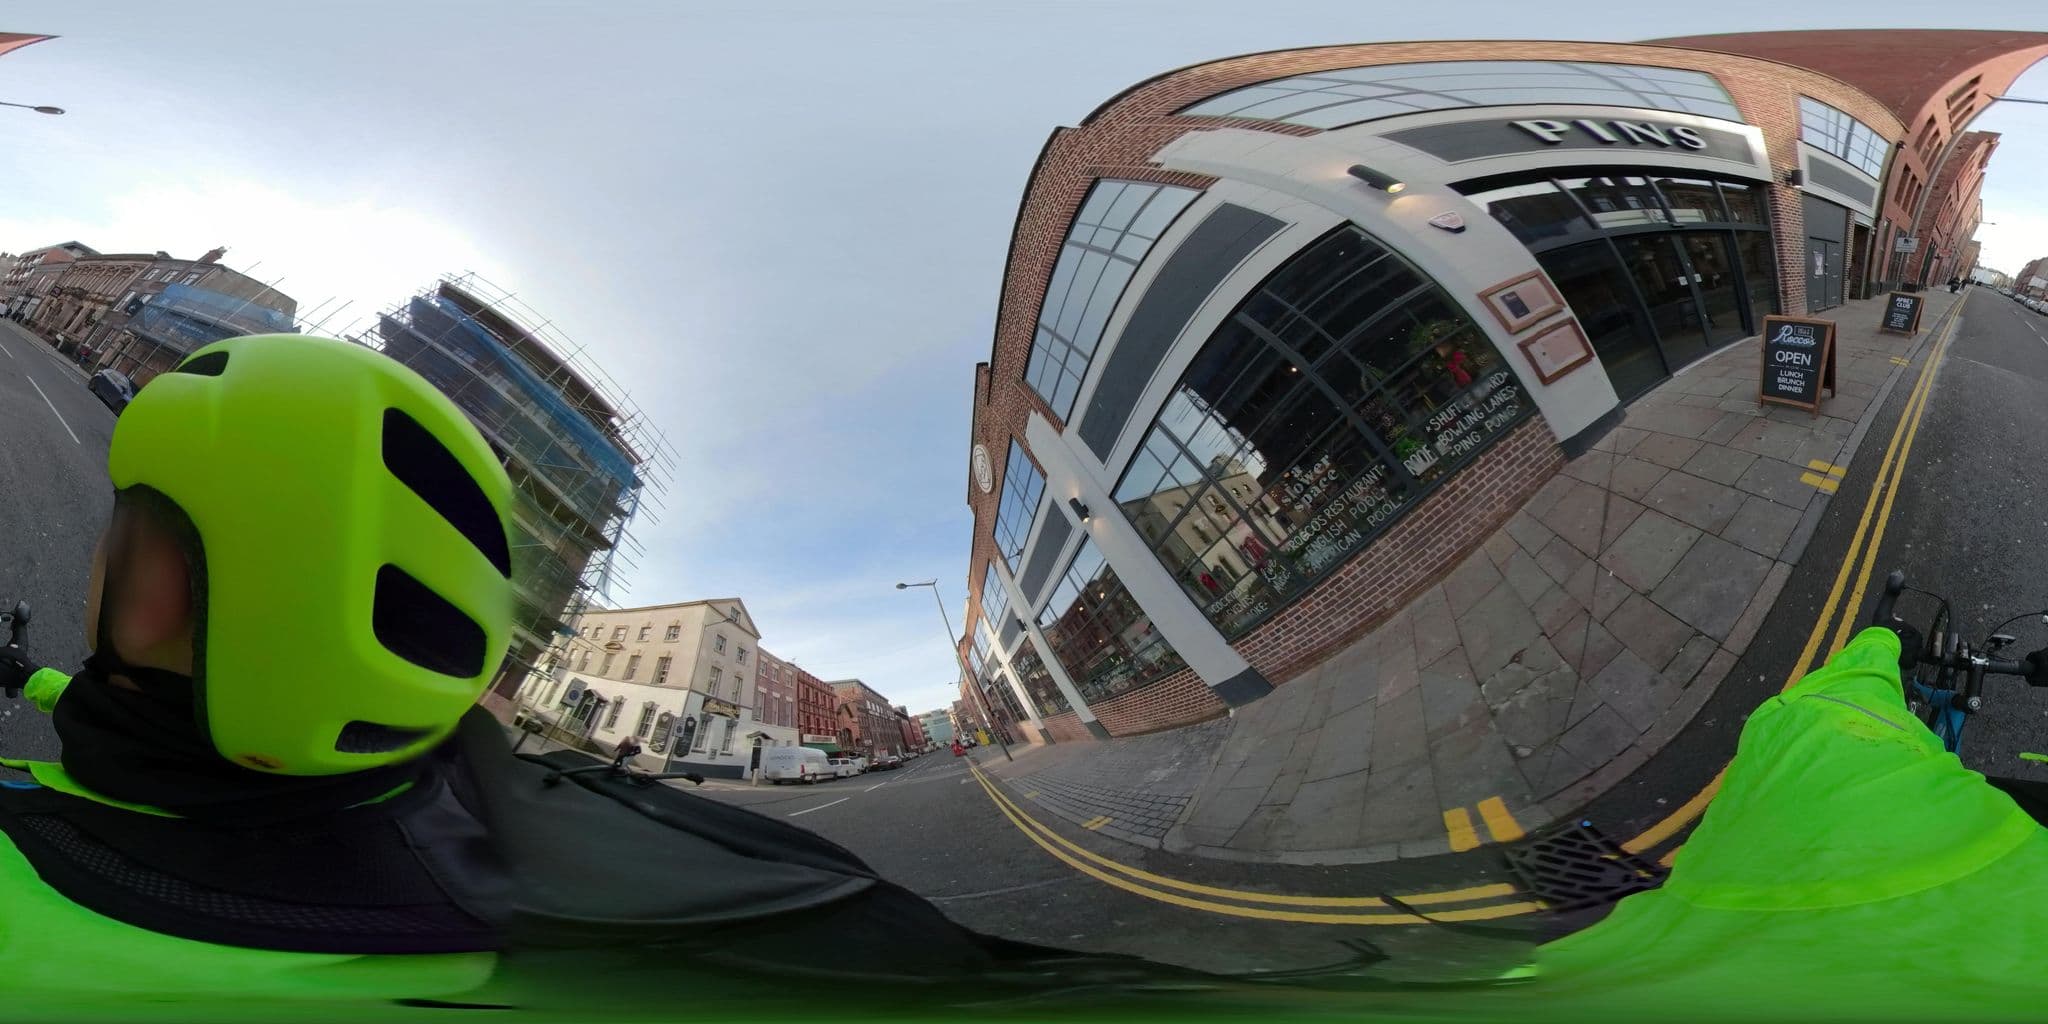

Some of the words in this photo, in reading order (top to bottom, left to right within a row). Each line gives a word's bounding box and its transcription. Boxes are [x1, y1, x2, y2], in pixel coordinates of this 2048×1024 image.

[1509, 119, 1707, 149] PINS
[1775, 350, 1812, 366] OPEN
[1780, 369, 1804, 379] LUNCH
[1777, 376, 1806, 388] BRUNCH
[1778, 383, 1803, 394] DINNER
[1437, 407, 1484, 447] BOWLING
[1483, 385, 1516, 414] LANES
[1453, 431, 1482, 456] PING
[1485, 405, 1517, 432] PONG
[1294, 468, 1339, 512] space
[1325, 465, 1384, 518] RESTAURANT
[1305, 519, 1347, 556] ENGLISH
[1349, 489, 1384, 518] POOL
[1311, 529, 1362, 573] AMERICAN
[1367, 499, 1402, 527] POOL
